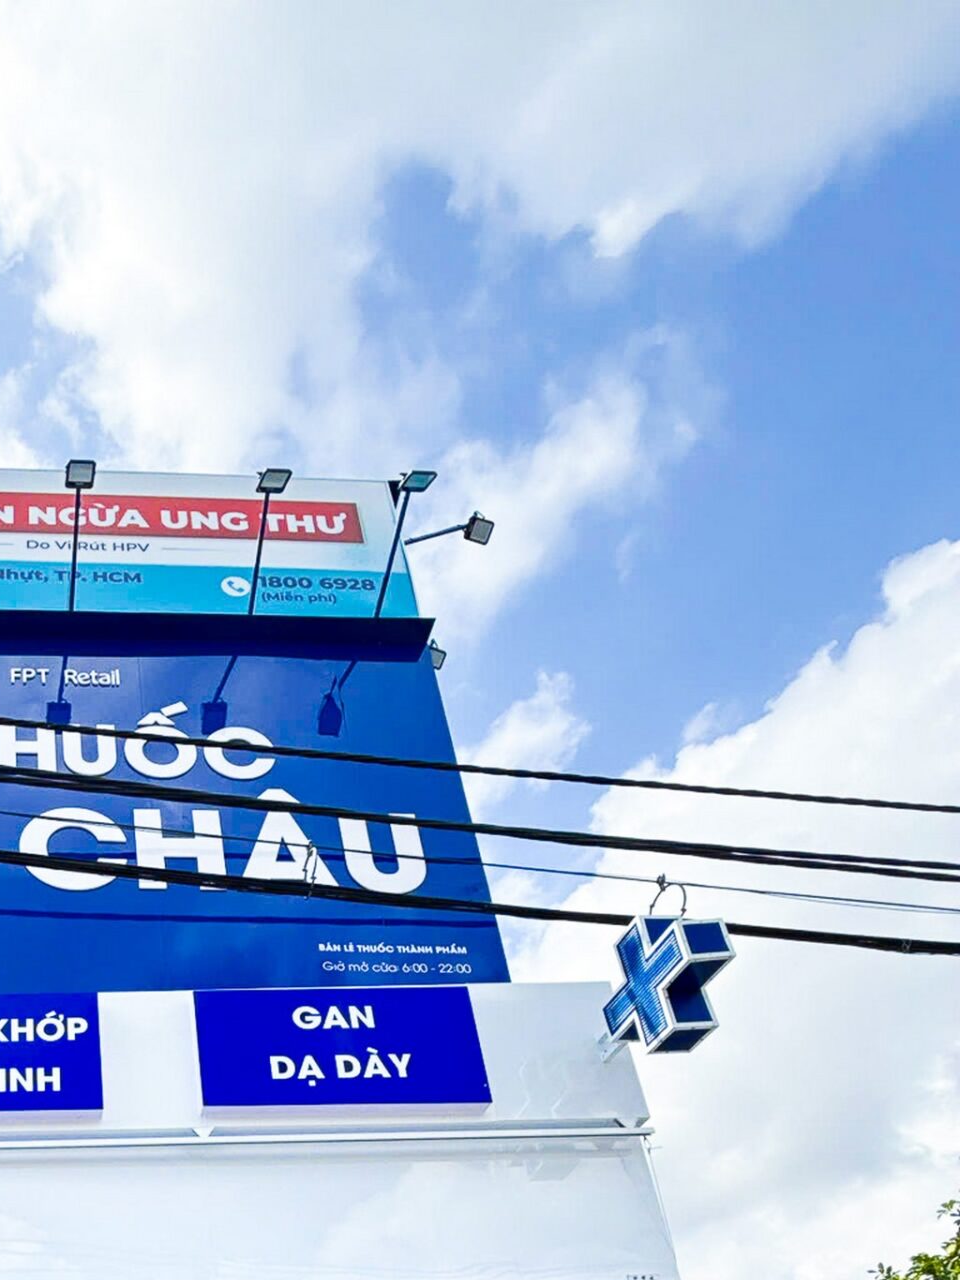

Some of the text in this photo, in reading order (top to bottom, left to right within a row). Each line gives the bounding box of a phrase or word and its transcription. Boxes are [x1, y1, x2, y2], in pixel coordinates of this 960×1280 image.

[28, 503, 150, 528] NGỪA
[160, 509, 249, 531] UNG
[259, 511, 347, 535] THƯ
[26, 540, 150, 552] Do Rút HPV
[93, 571, 142, 583] HCM
[258, 576, 375, 591] 1800 6928
[10, 668, 120, 688] FPT Retail
[19, 788, 429, 895] CHÂU
[357, 941, 394, 953] THUỐC
[396, 943, 433, 954] THÀNH
[322, 961, 345, 971] Giờ
[348, 961, 369, 972] mở
[402, 963, 428, 973] 6:00
[438, 964, 472, 974] 22:00
[291, 1005, 376, 1031] GAN
[269, 1046, 412, 1087] DẠ DÀY
